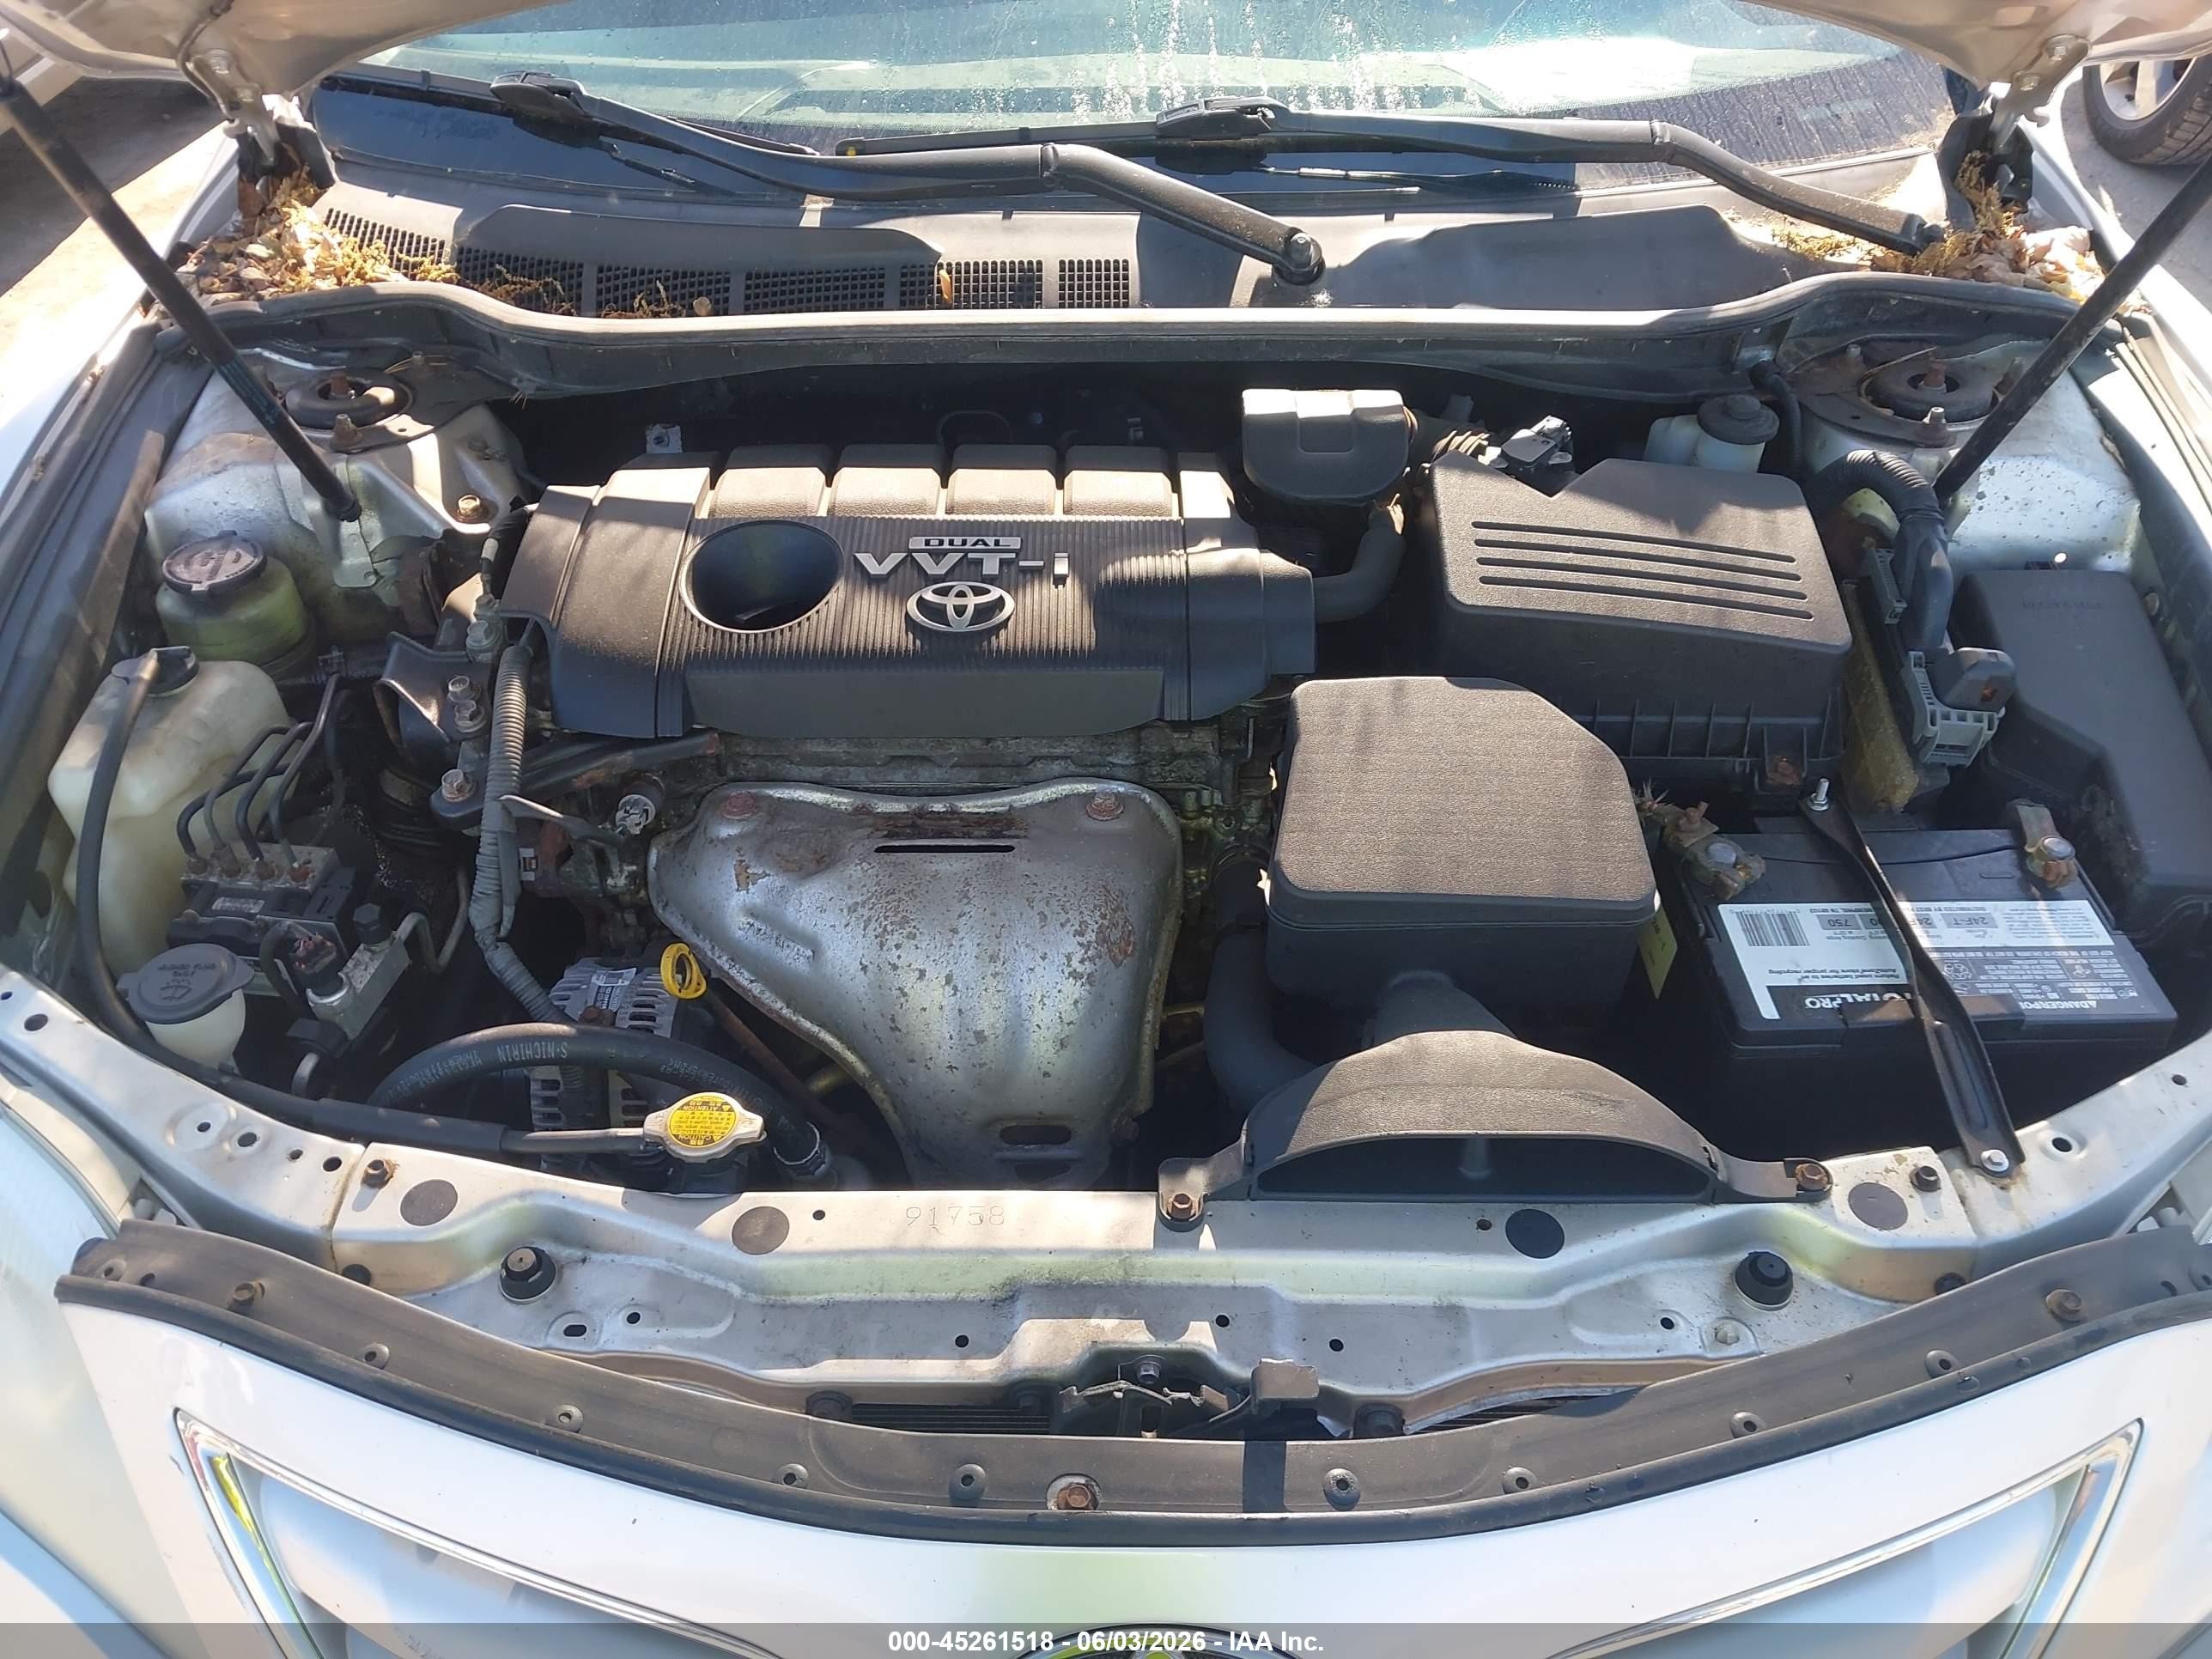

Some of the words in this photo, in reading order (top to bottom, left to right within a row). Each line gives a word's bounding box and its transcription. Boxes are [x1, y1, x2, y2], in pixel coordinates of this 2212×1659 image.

[923, 538, 1012, 548] DUAL
[853, 551, 1070, 579] VVT-i
[1827, 919, 1852, 927] 750
[905, 1205, 1006, 1227] 91758
